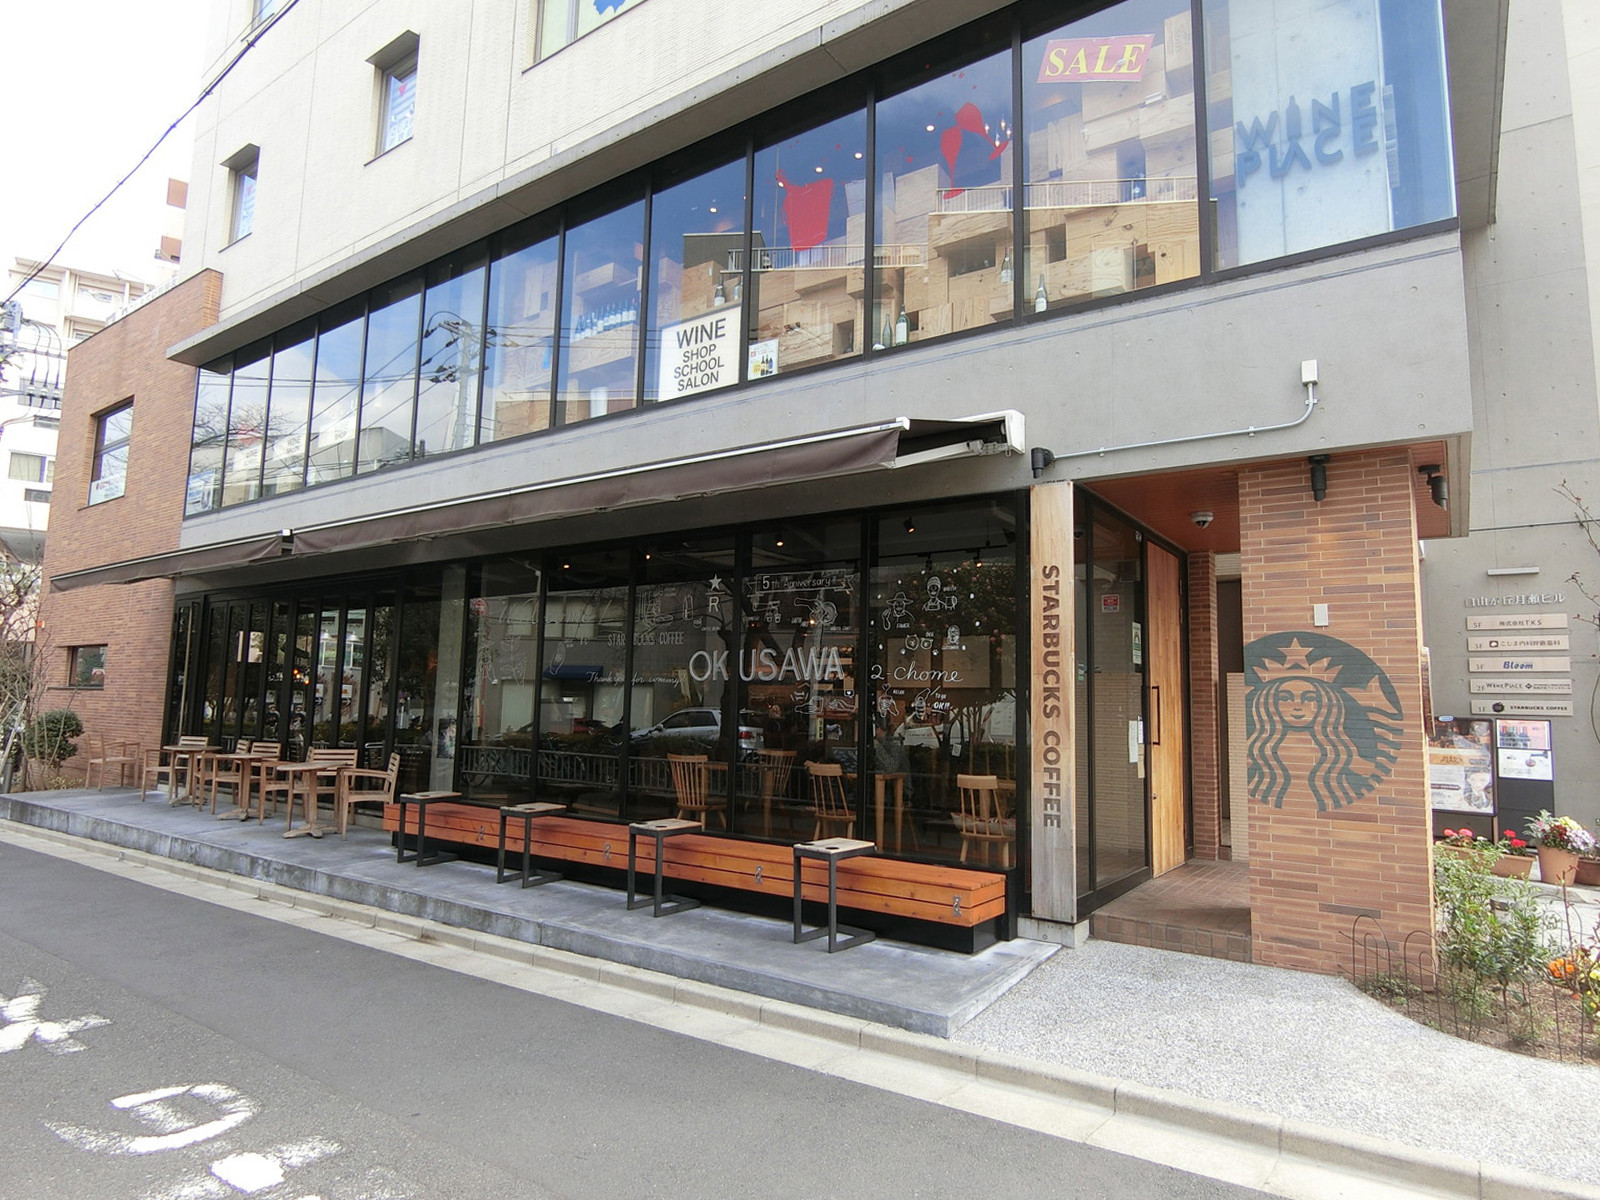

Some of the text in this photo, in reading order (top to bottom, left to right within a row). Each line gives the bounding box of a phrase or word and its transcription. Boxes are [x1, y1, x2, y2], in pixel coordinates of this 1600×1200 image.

[1045, 44, 1145, 77] SALE
[1236, 80, 1378, 150] WINE
[1237, 116, 1379, 188] PLACE
[676, 318, 727, 349] WINE
[682, 343, 717, 363] SHOP
[674, 356, 725, 379] SCHOOL
[677, 371, 719, 392] SALON
[708, 596, 720, 613] R
[659, 631, 685, 645] COFFEE
[1503, 660, 1533, 670] Bloom
[1042, 565, 1061, 829] STARBUCKS COFFEE
